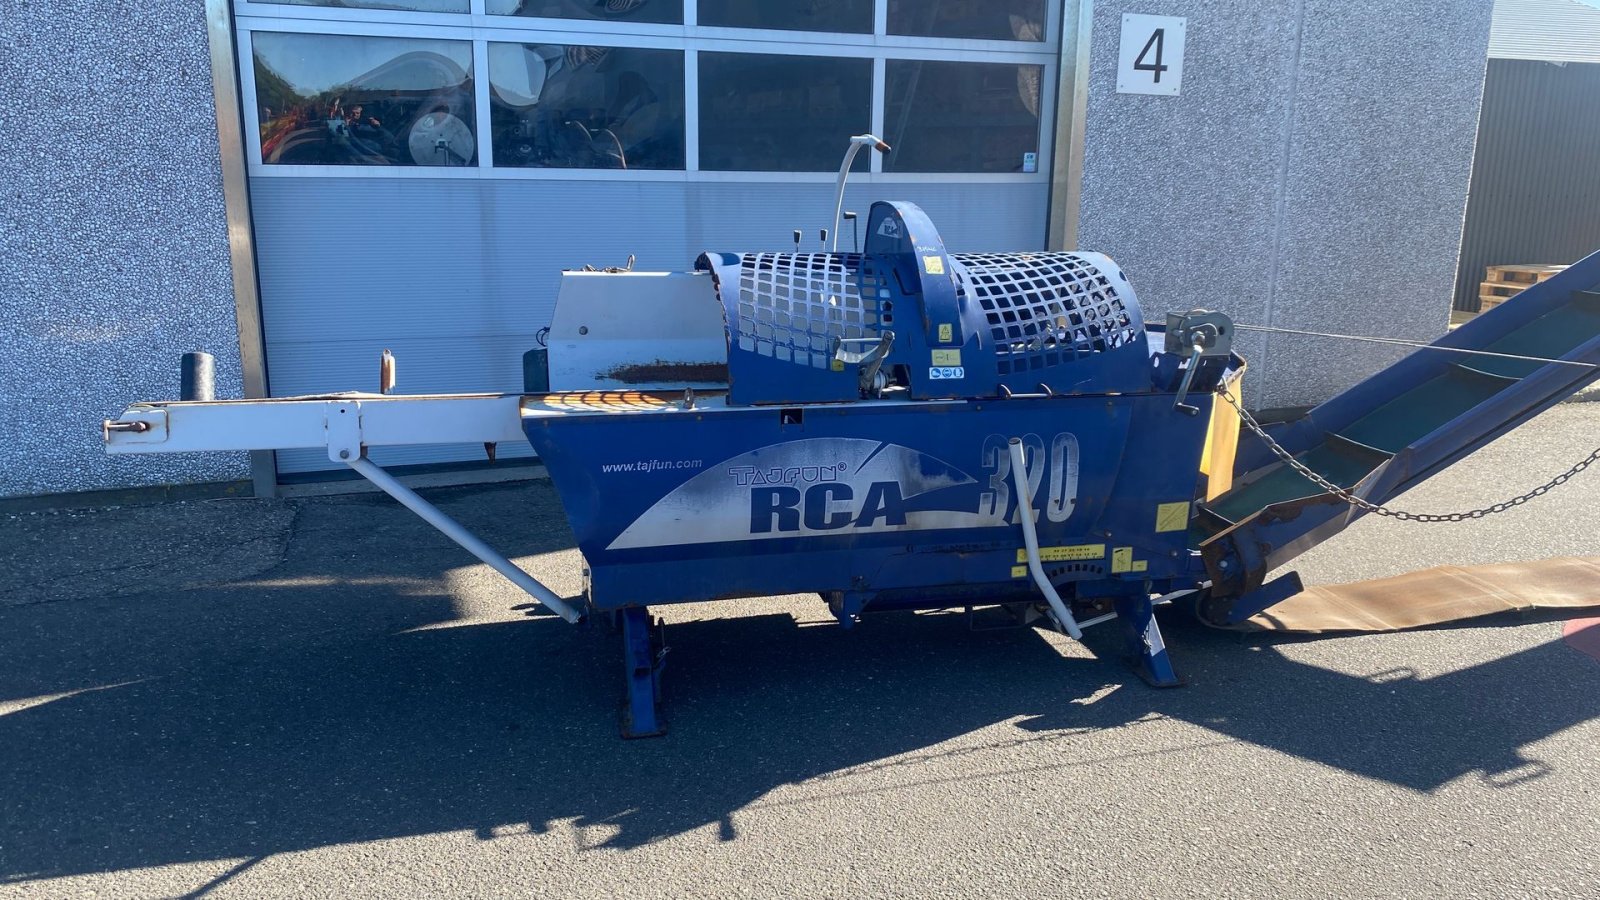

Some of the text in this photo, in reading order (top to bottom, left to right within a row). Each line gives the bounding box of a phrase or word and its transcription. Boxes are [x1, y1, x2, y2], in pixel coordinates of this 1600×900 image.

[1133, 28, 1168, 84] 4
[602, 457, 703, 474] www.tajfun.com
[750, 432, 1080, 534] RCA 320
